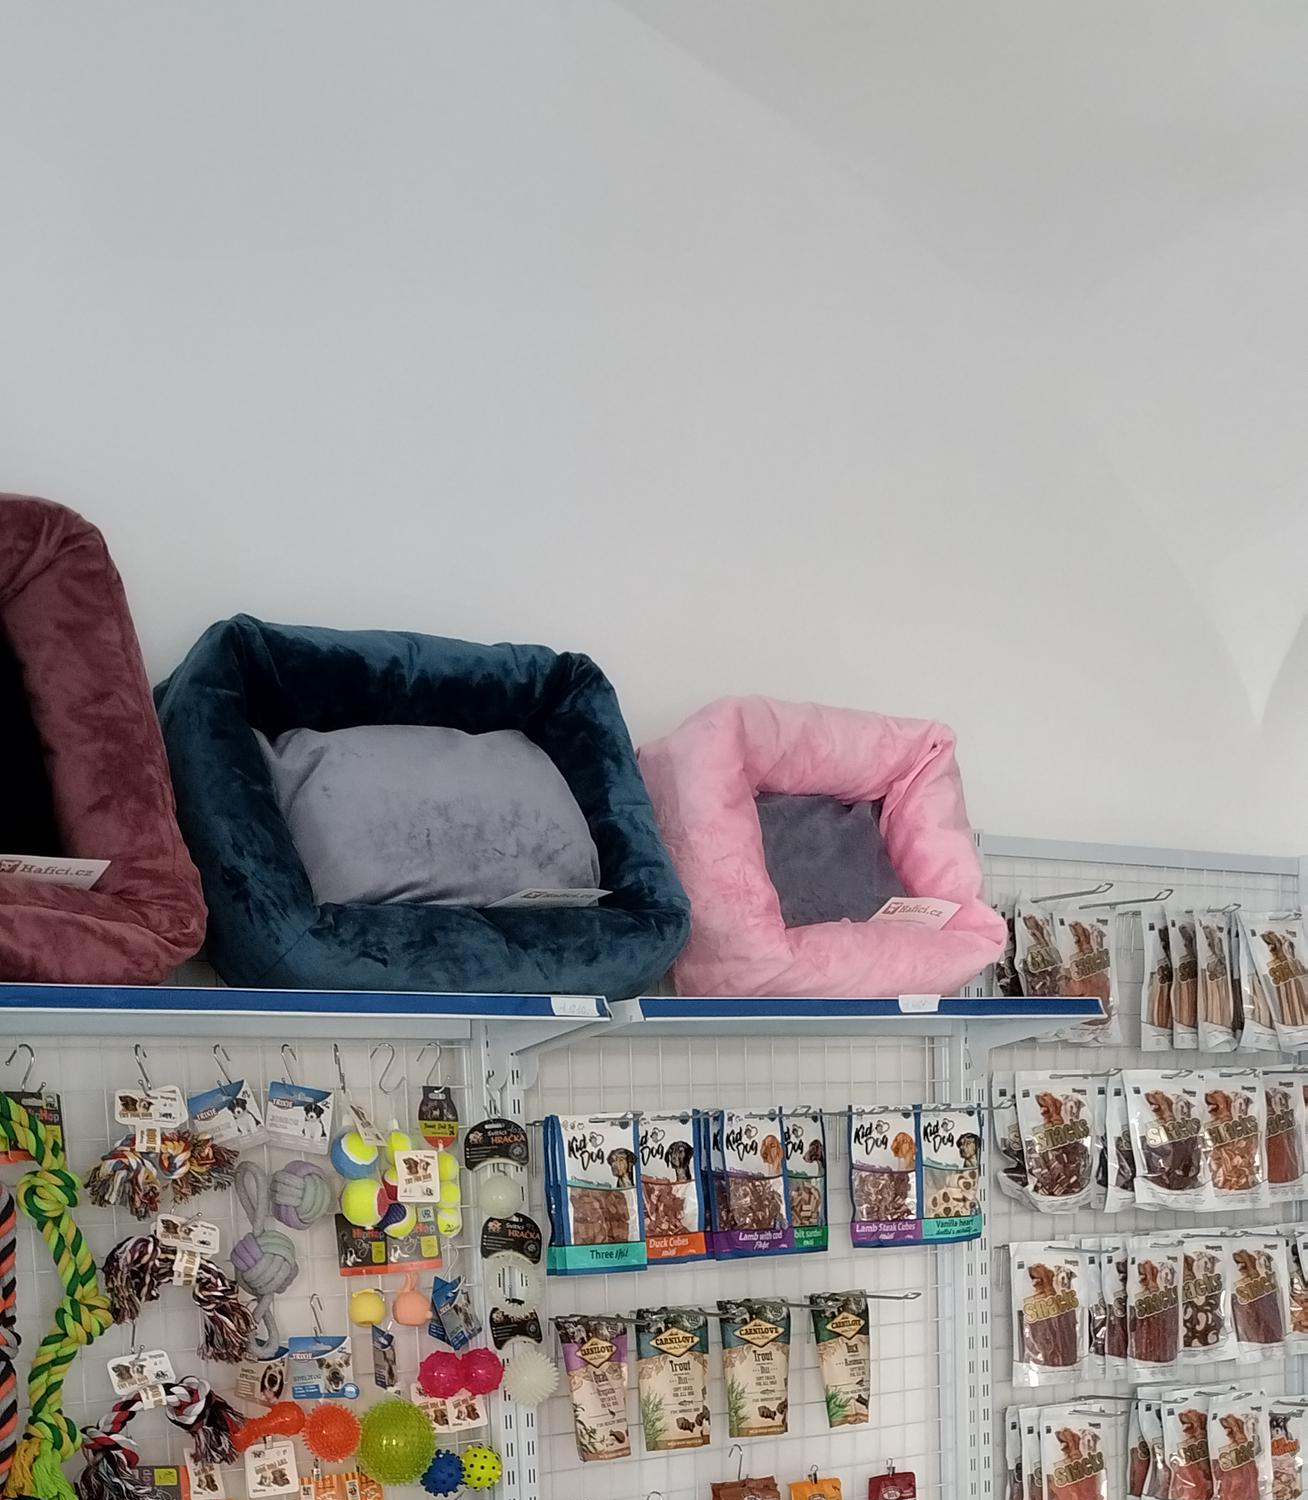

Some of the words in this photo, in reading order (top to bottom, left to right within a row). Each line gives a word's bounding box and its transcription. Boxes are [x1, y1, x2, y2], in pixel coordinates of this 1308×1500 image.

[854, 1123, 873, 1145] Kid
[923, 1121, 939, 1143] Kid
[726, 1127, 743, 1151] Kid
[568, 1134, 588, 1159] Kid
[856, 1223, 878, 1232] Lamb
[879, 1222, 897, 1231] Steak
[936, 1219, 958, 1228] Vanilla
[739, 1231, 759, 1241] Lamb
[590, 1249, 614, 1260] Three
[1183, 1273, 1222, 1301] acks
[831, 1319, 861, 1329] CARNILOVE
[739, 1327, 779, 1336] CARNILOVE
[655, 1336, 695, 1346] CARNILOVE
[753, 1350, 773, 1361] Trout
[669, 1360, 691, 1373] Trout
